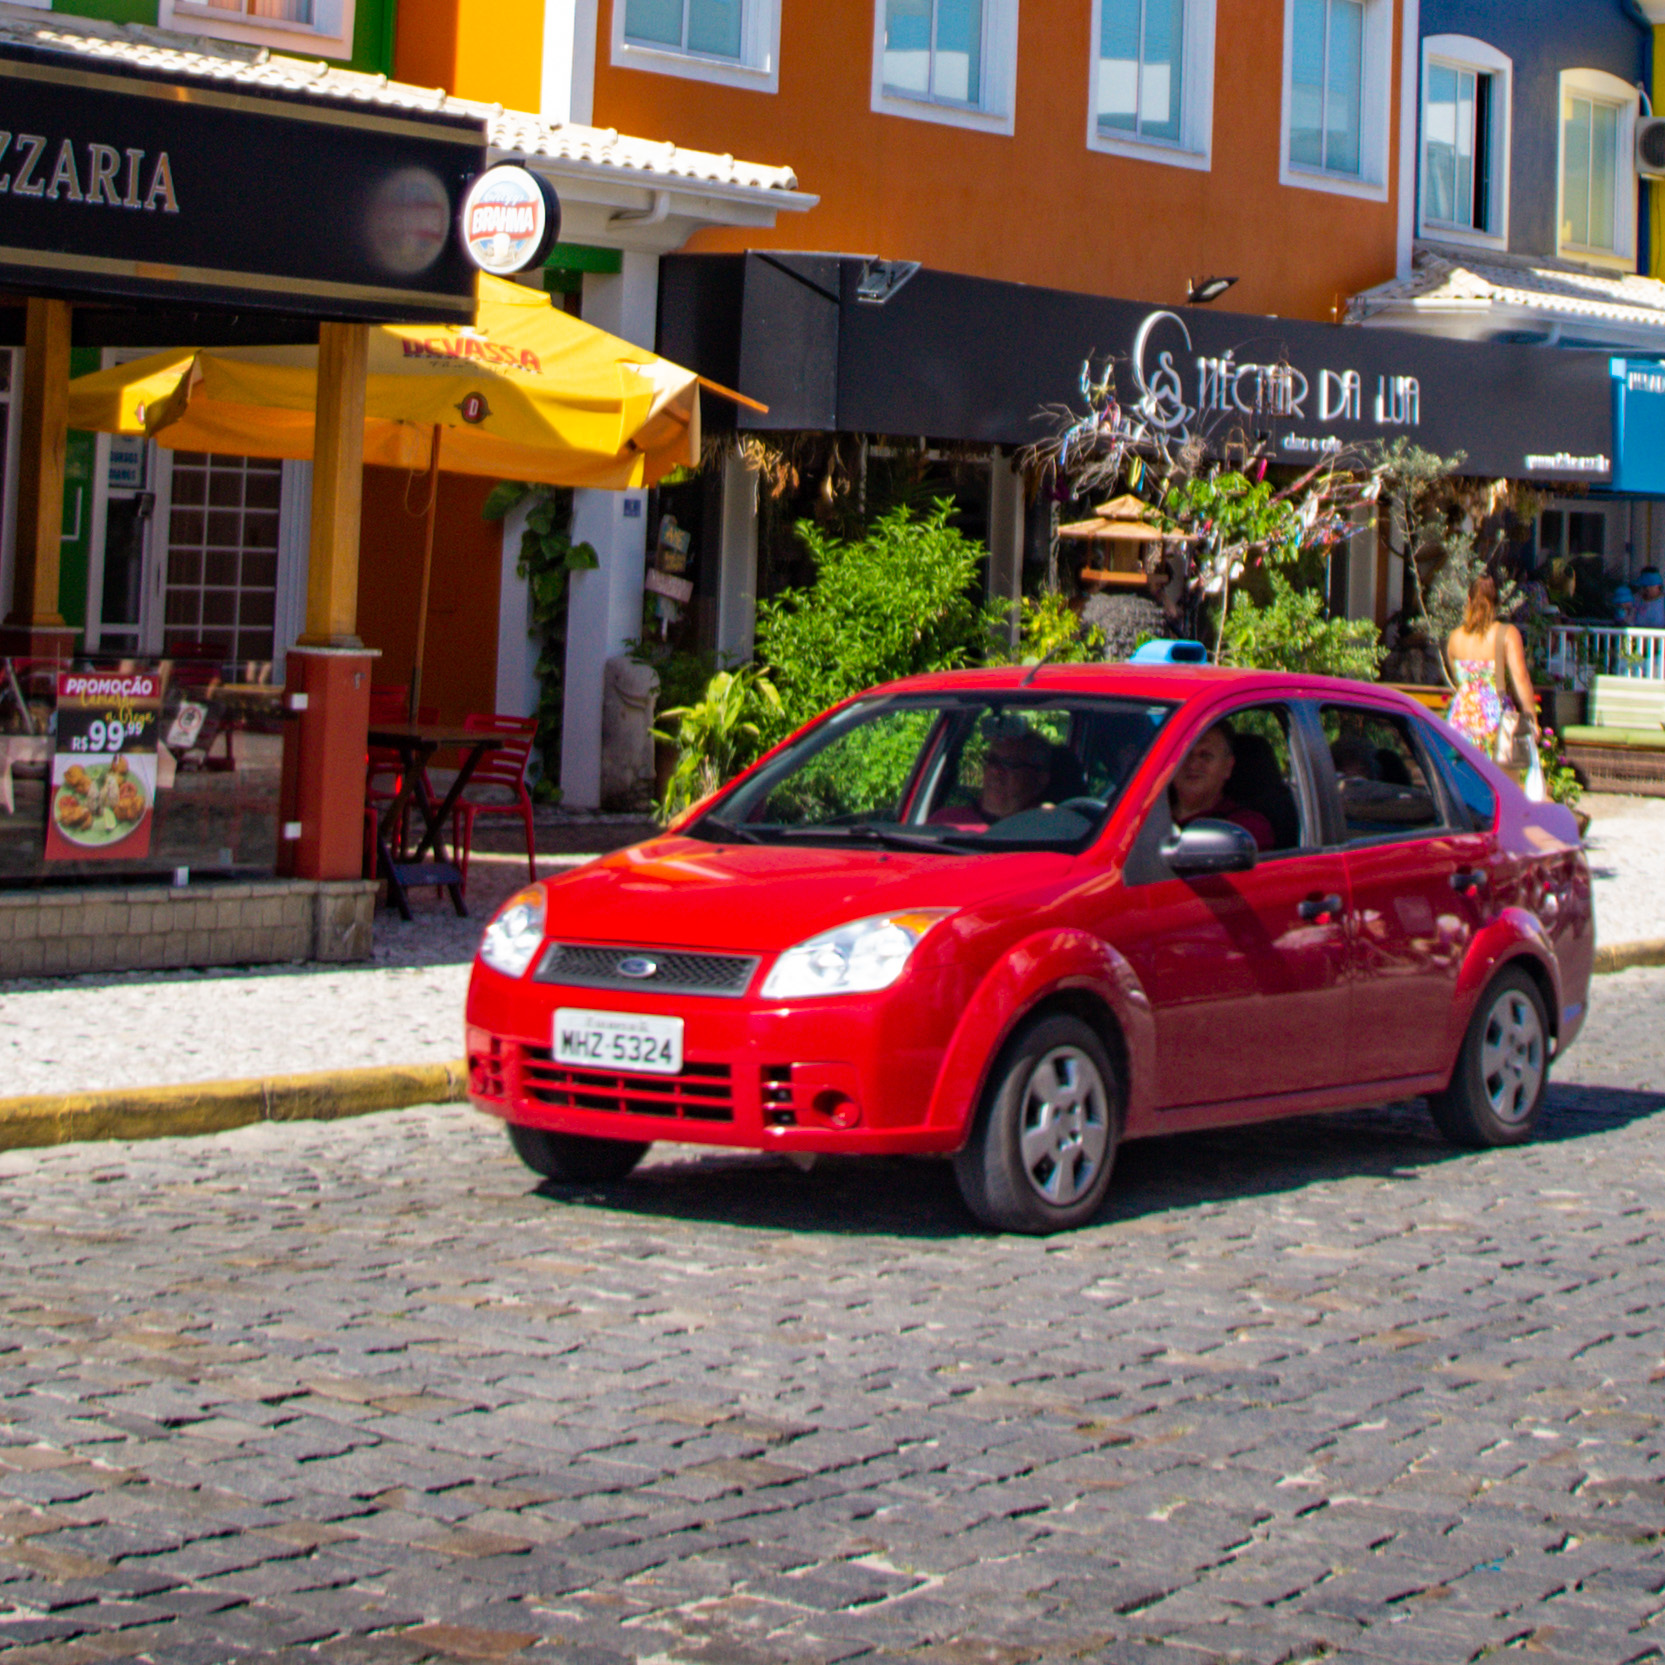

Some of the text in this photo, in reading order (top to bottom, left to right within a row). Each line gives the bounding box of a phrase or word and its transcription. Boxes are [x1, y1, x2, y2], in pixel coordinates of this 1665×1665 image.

[471, 205, 535, 235] BRAHMA
[401, 337, 542, 373] DEVASSA
[1319, 369, 1361, 421] DA
[1375, 375, 1420, 426] LUA
[65, 676, 153, 698] PROMOÇÃO
